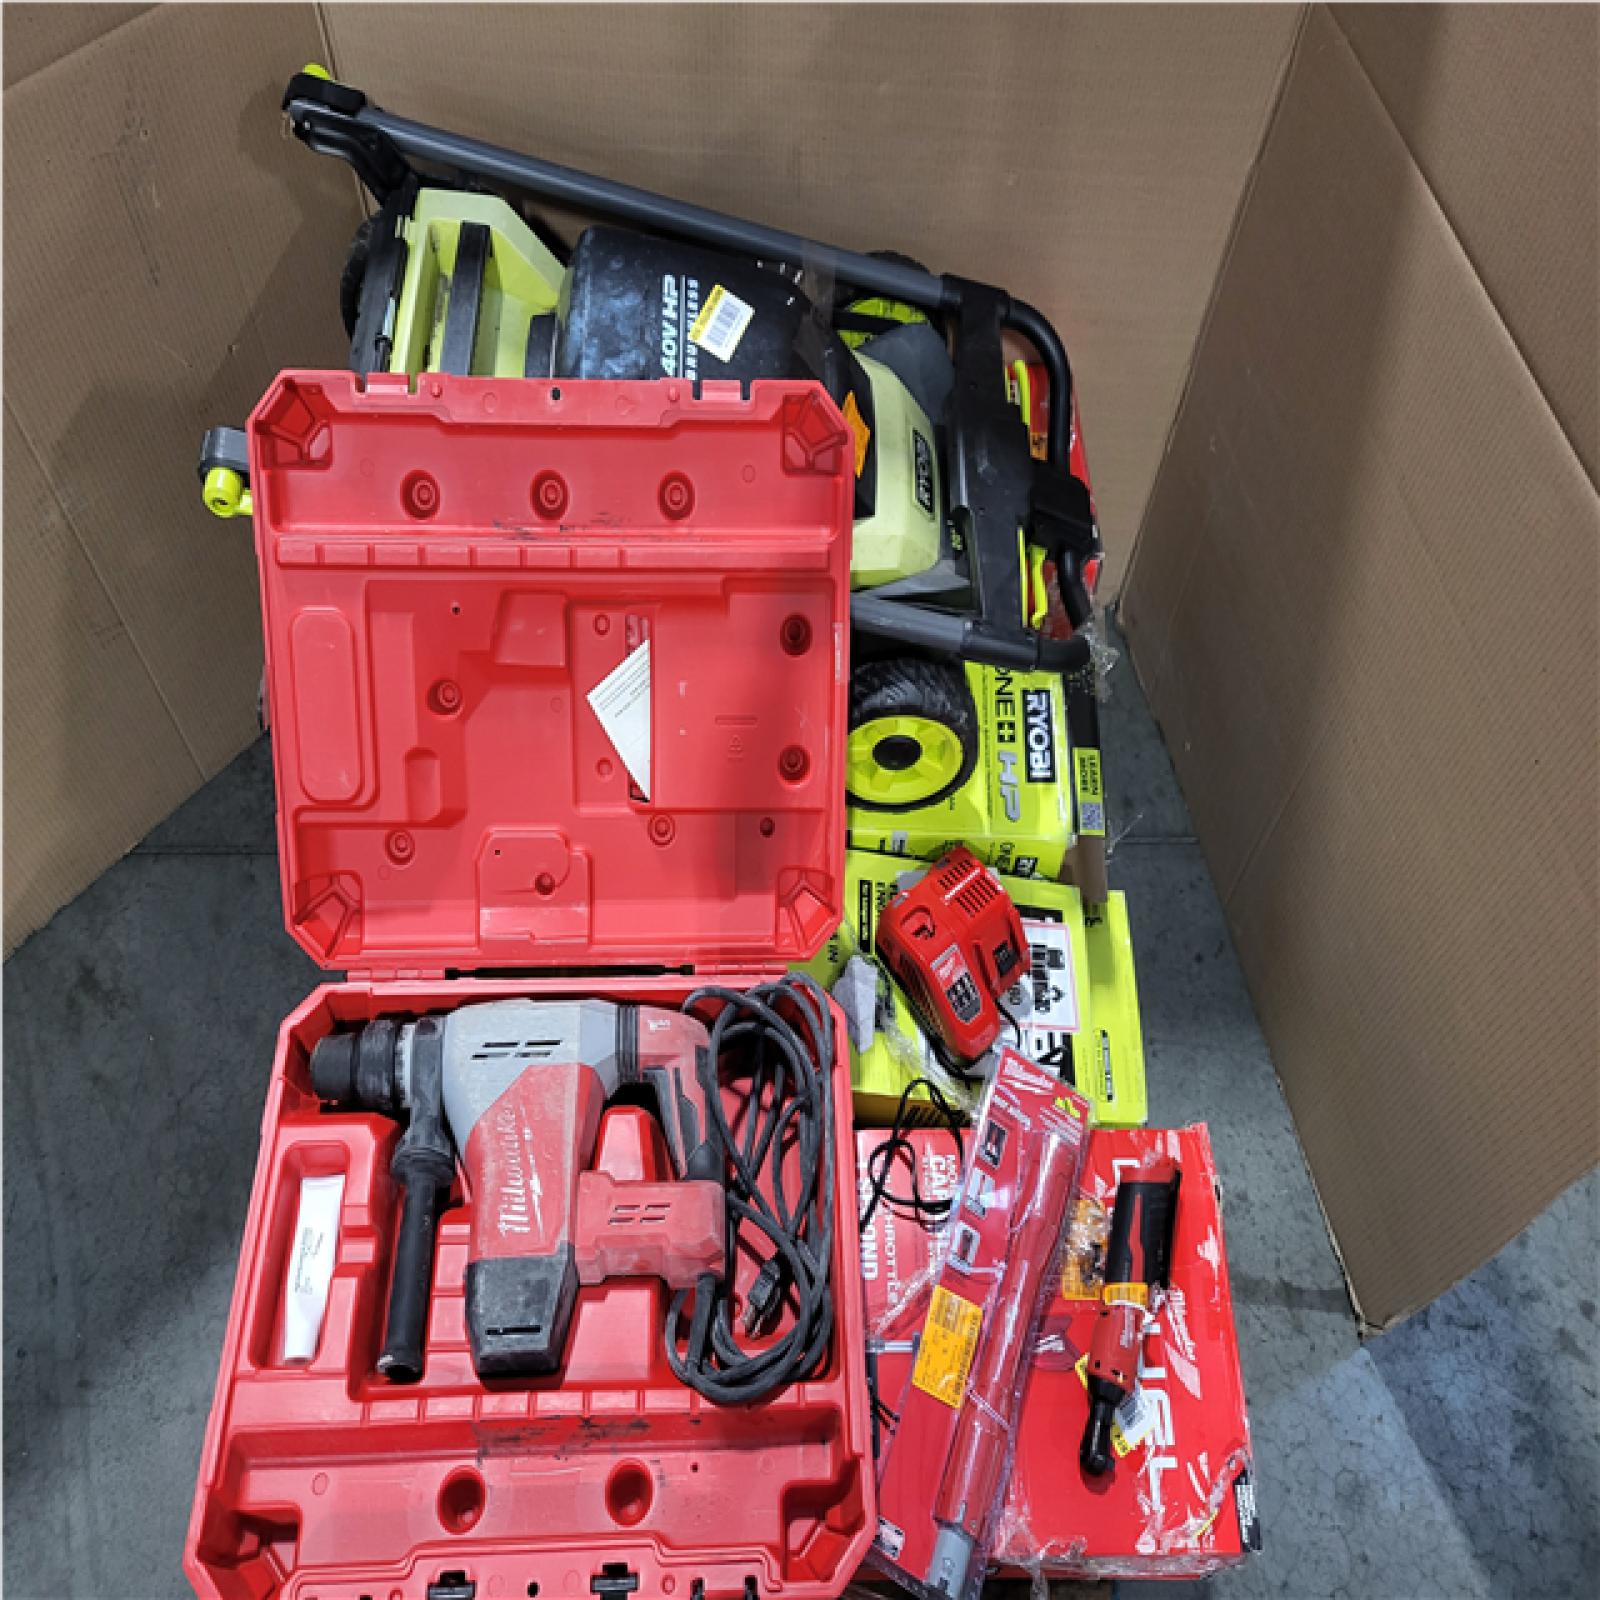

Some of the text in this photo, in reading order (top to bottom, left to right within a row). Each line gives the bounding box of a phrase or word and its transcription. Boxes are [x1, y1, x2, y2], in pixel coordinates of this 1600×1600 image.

[662, 274, 679, 377] 40V HP
[1026, 691, 1052, 779] RYOBI
[997, 750, 1021, 824] HP
[496, 1101, 532, 1238] Milwaukee
